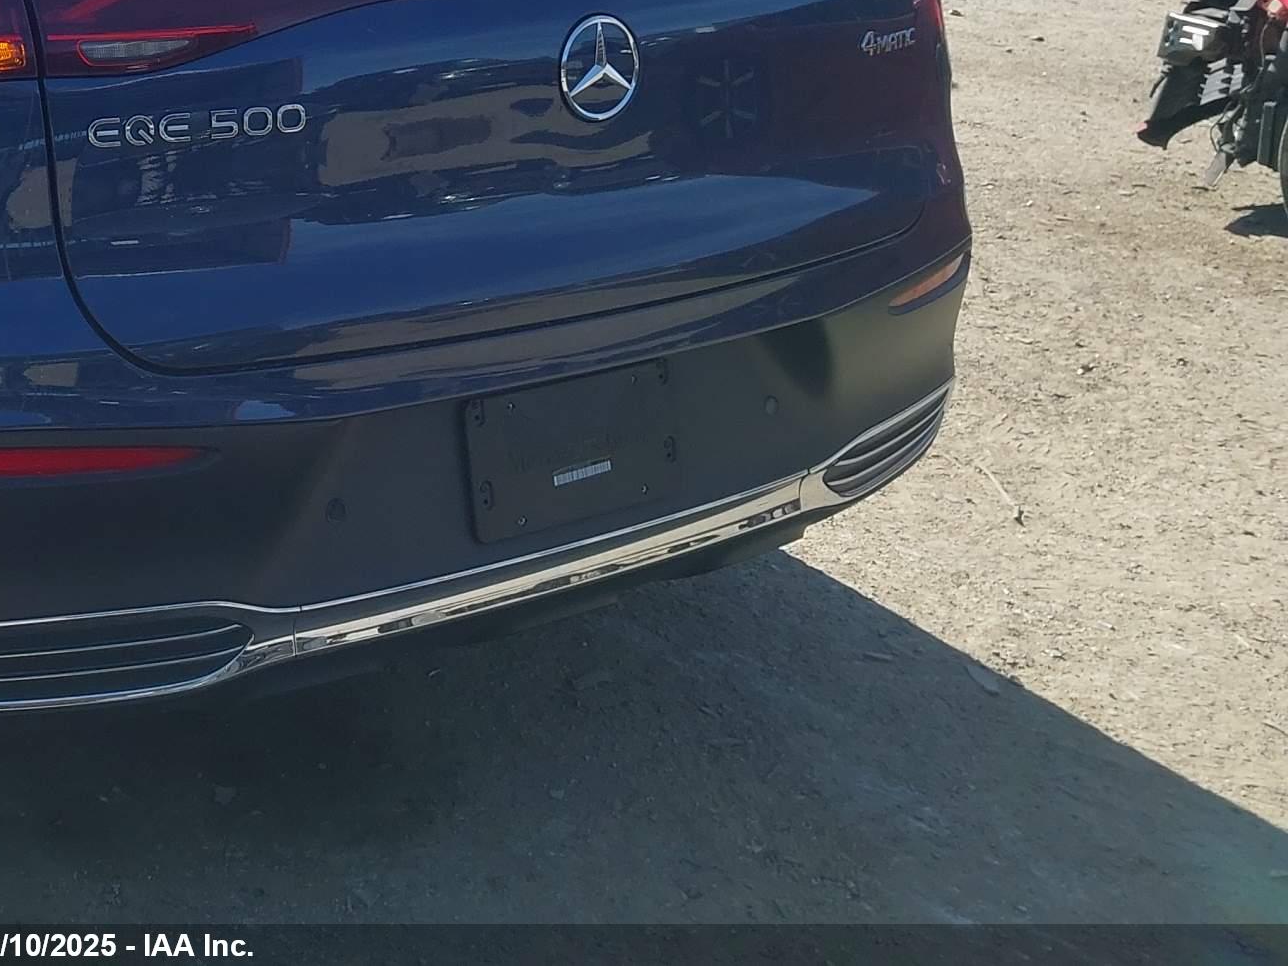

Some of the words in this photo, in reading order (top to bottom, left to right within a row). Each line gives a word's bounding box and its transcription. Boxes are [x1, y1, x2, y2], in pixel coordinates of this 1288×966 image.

[861, 26, 916, 55] 4MATIC
[87, 112, 191, 148] EQE
[209, 103, 307, 140] 500
